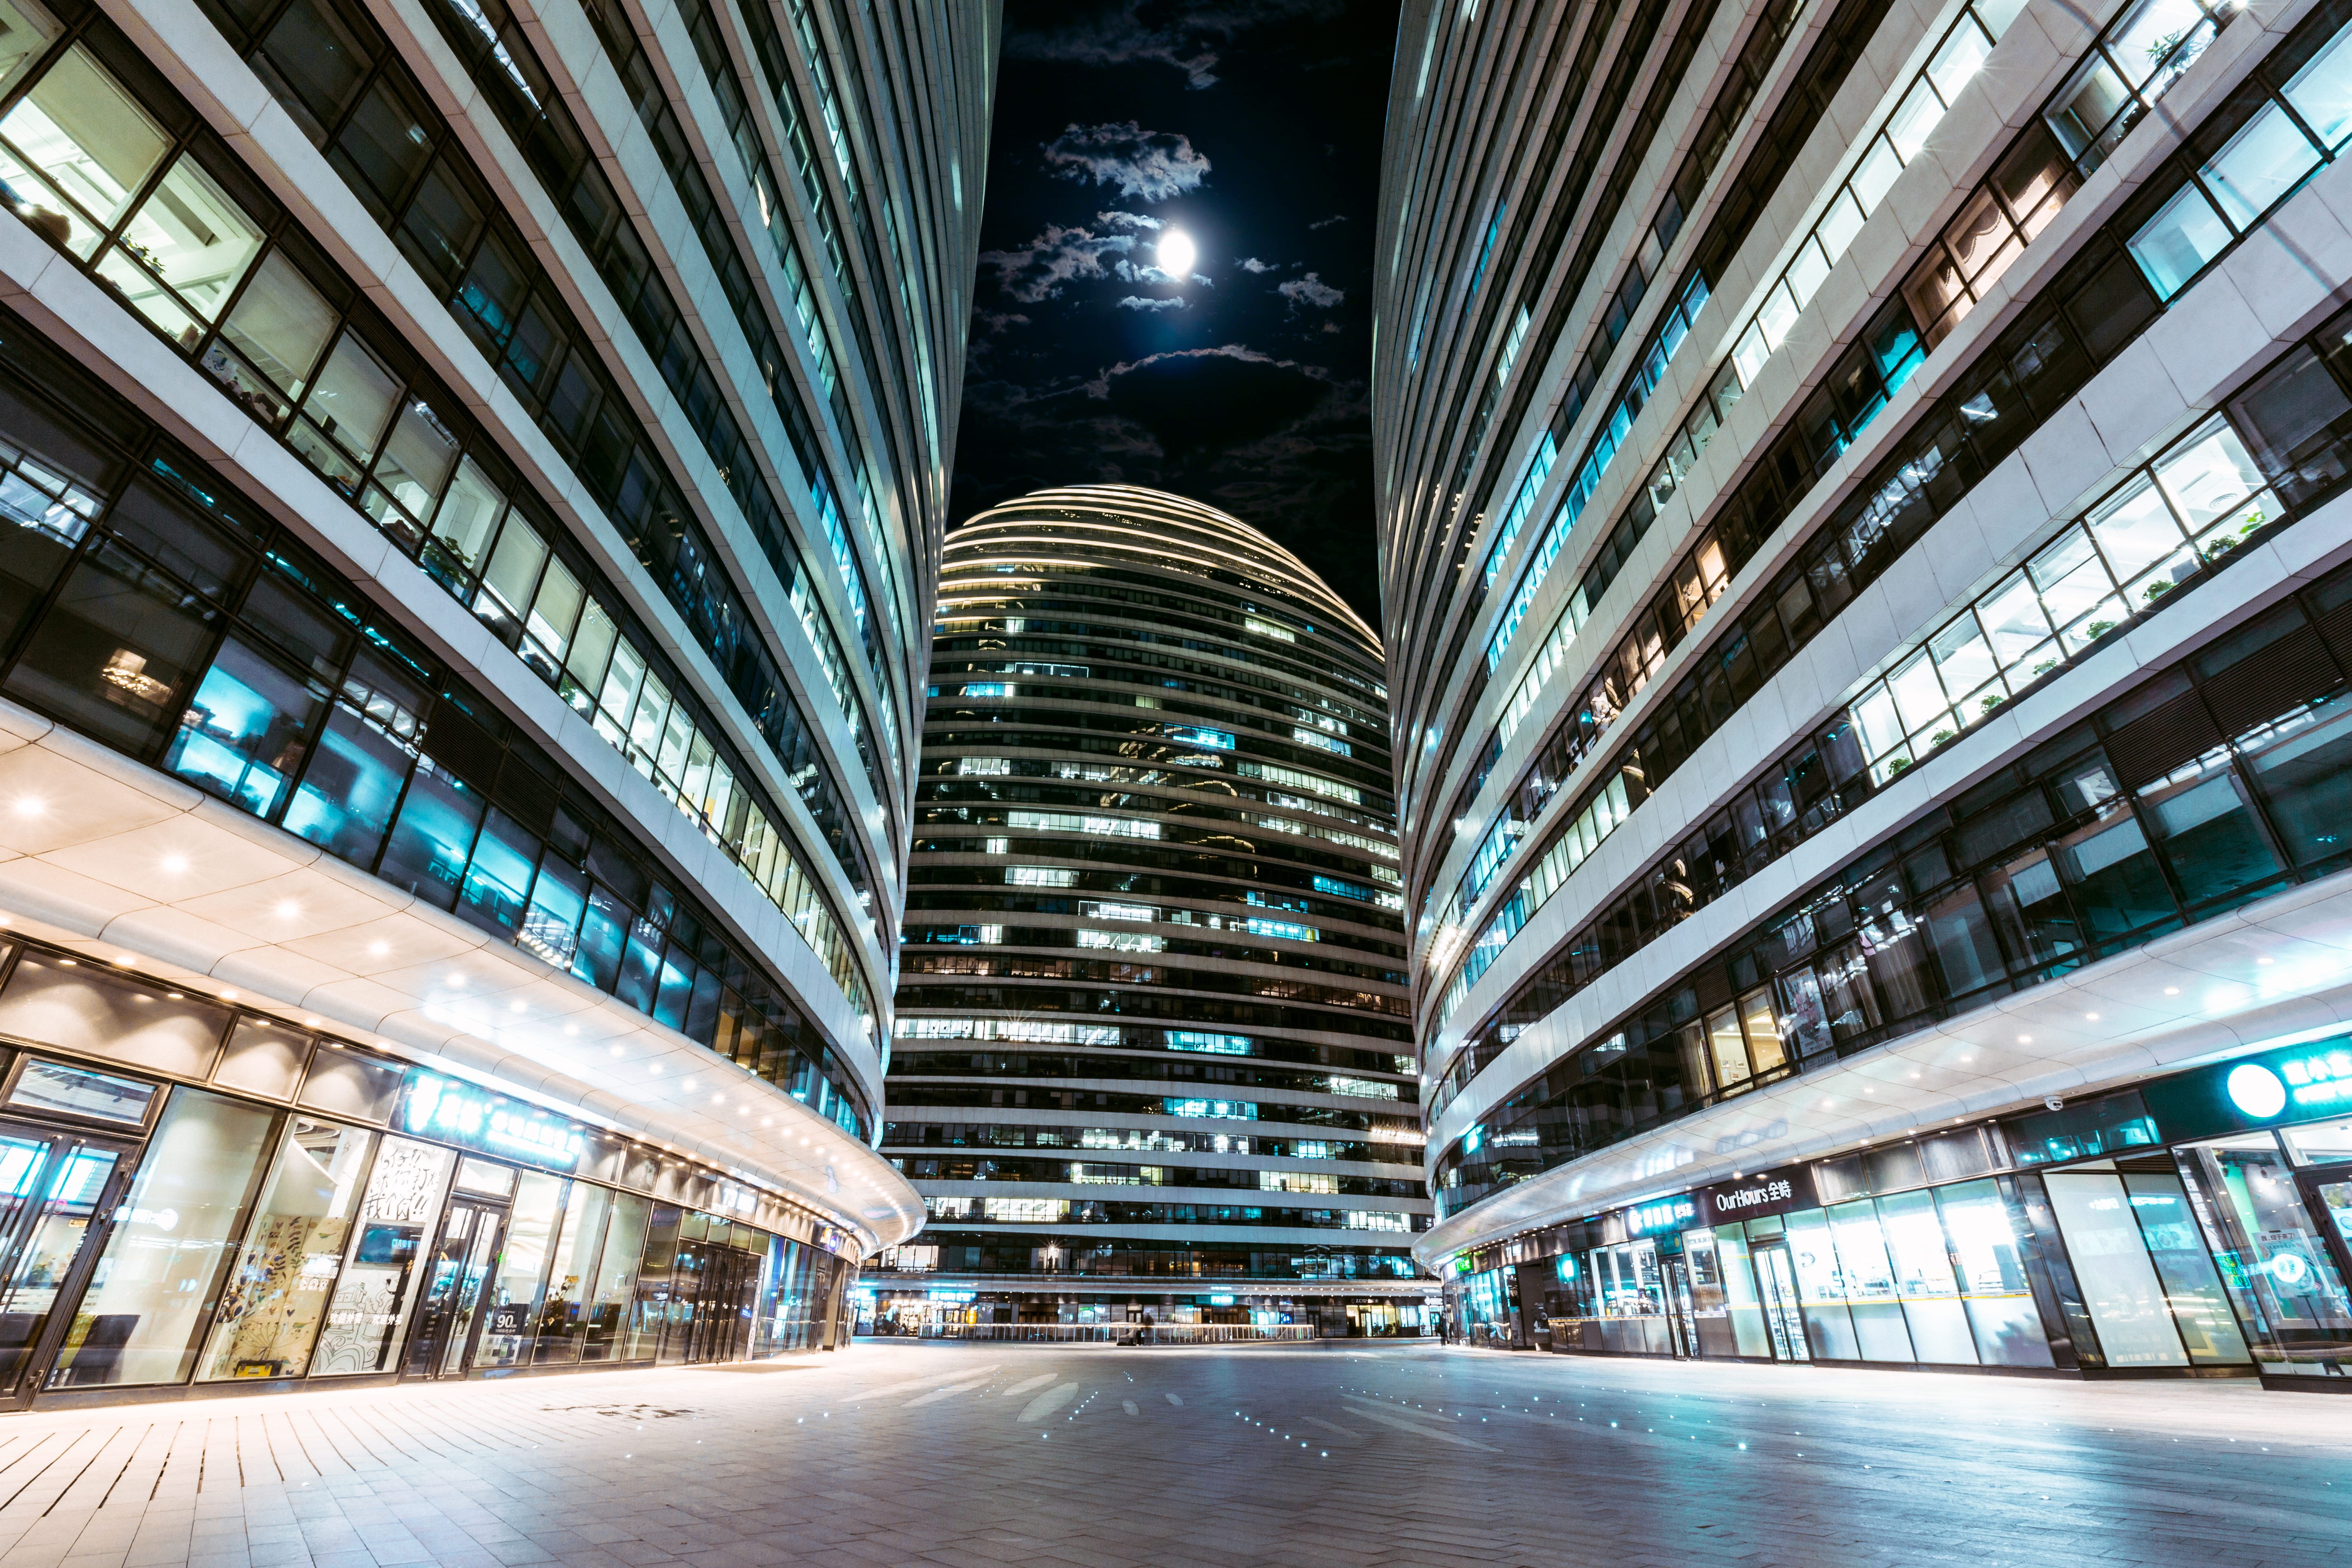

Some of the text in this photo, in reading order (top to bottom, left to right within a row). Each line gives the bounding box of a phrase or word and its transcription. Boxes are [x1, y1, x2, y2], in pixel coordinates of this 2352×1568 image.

[1717, 1189, 1768, 1211] OurHours
[1768, 1180, 1791, 1201] 全時
[752, 1264, 764, 1325] SOHO
[497, 1314, 514, 1328] 90
